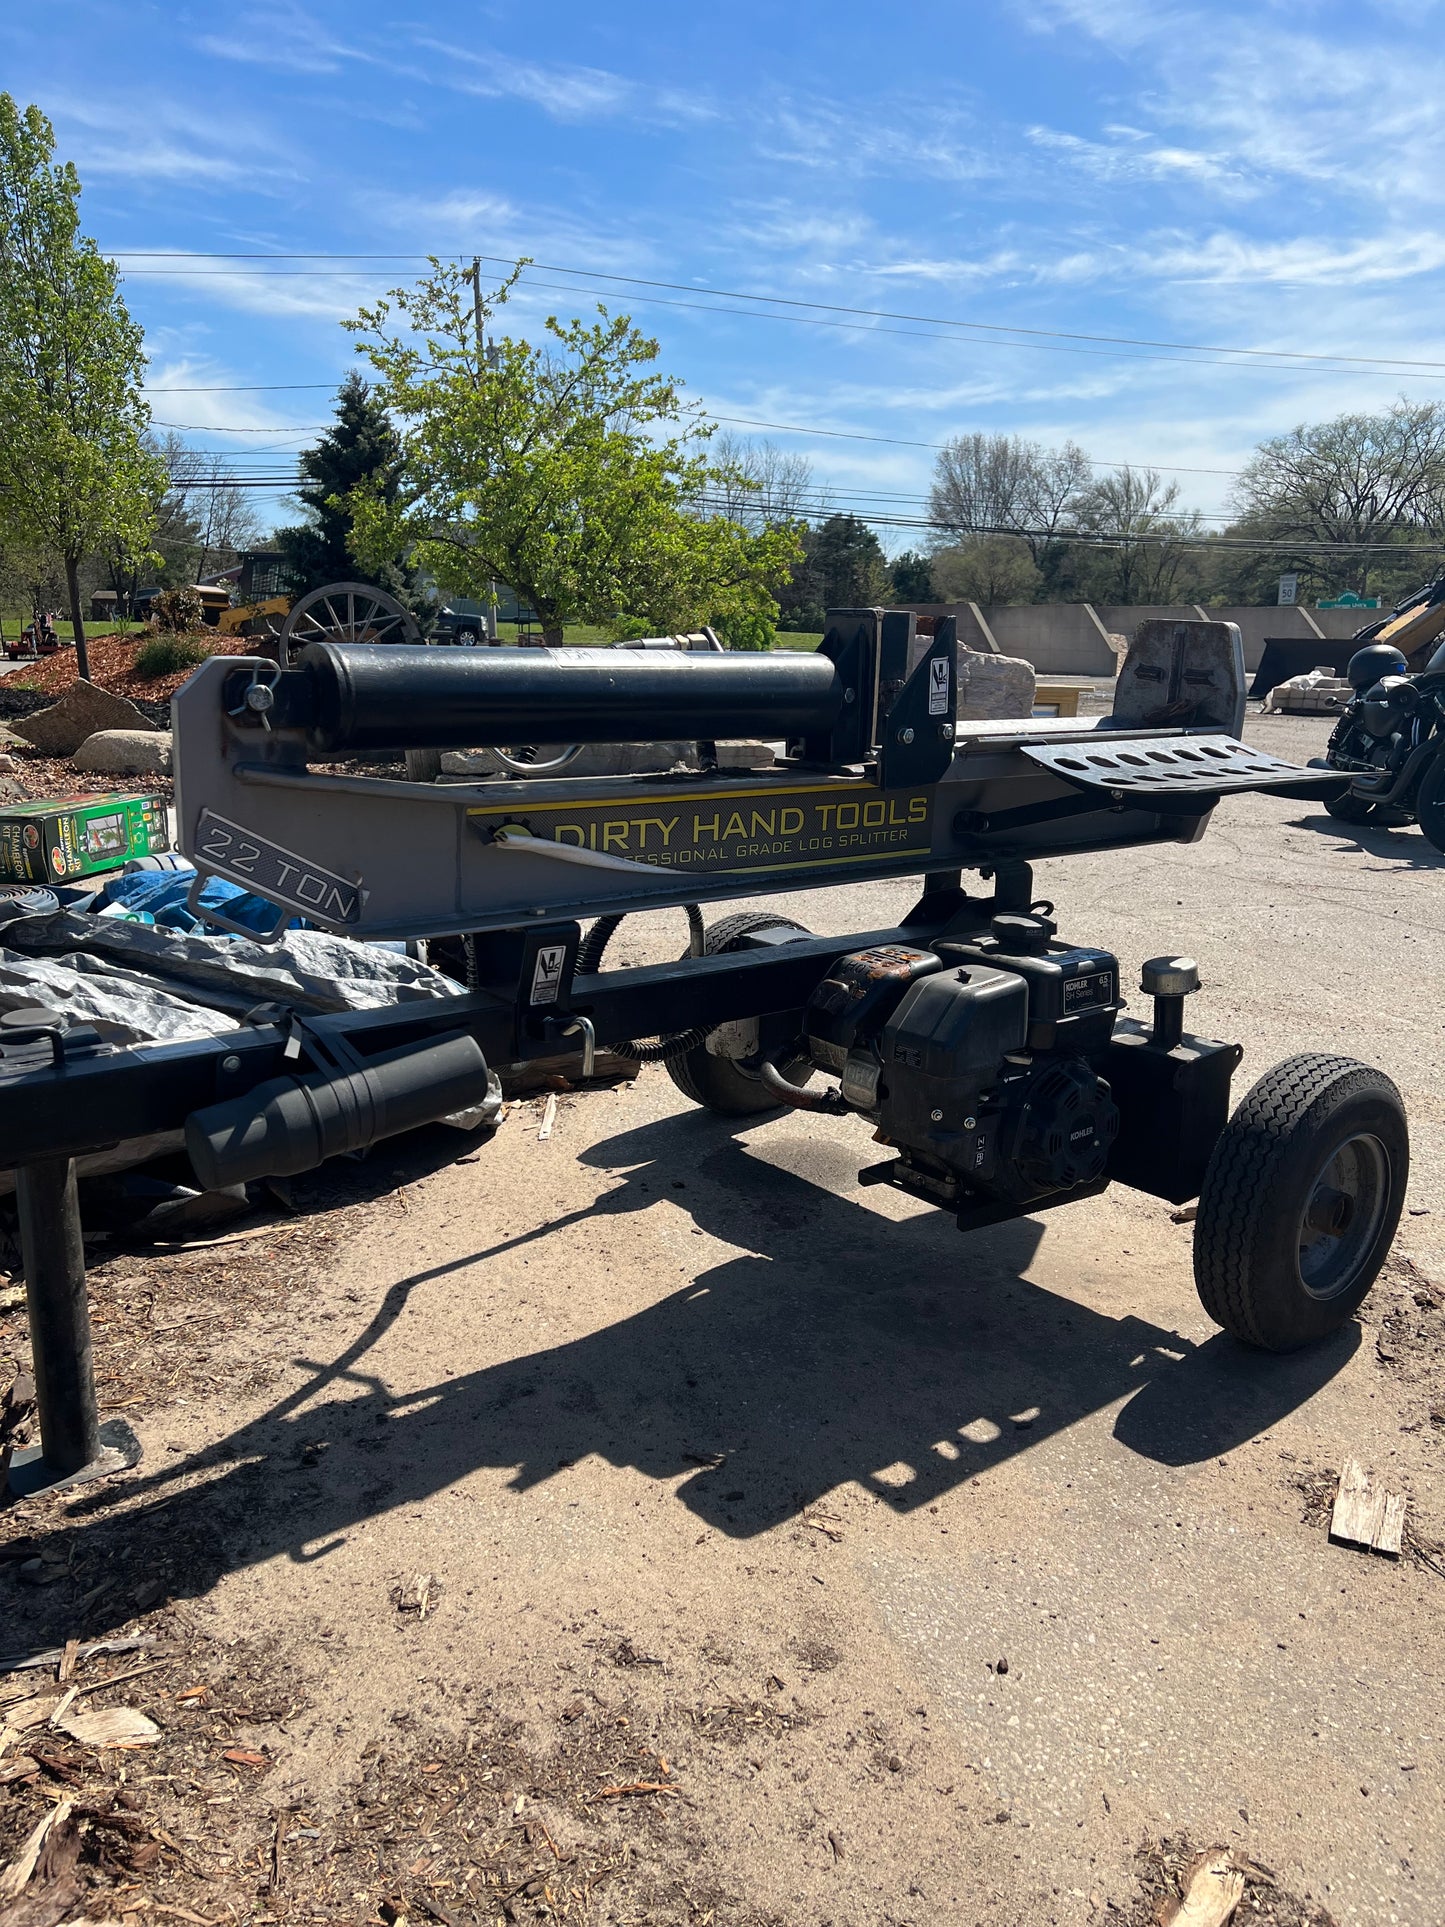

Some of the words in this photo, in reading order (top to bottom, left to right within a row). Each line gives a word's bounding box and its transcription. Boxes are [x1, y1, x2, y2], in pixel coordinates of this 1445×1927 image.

[1282, 588, 1293, 598] 50
[3, 825, 11, 838] KIT
[555, 816, 680, 851] DIRTY
[693, 807, 805, 843] HAND
[815, 797, 928, 831] TOOLS
[11, 825, 25, 879] CHAMELEON
[62, 817, 75, 872] CHAMELEON
[624, 848, 729, 866] ESSIONAL
[736, 840, 793, 857] GRADE
[800, 836, 833, 851] LOG
[838, 829, 908, 848] SPLITTER
[74, 856, 82, 871] KIT
[201, 828, 262, 873] 22
[276, 859, 355, 918] TON
[1066, 980, 1088, 992] KOHLER
[1065, 991, 1075, 1001] SH
[1076, 989, 1094, 999] Series
[1070, 1126, 1094, 1141] KOHLER
